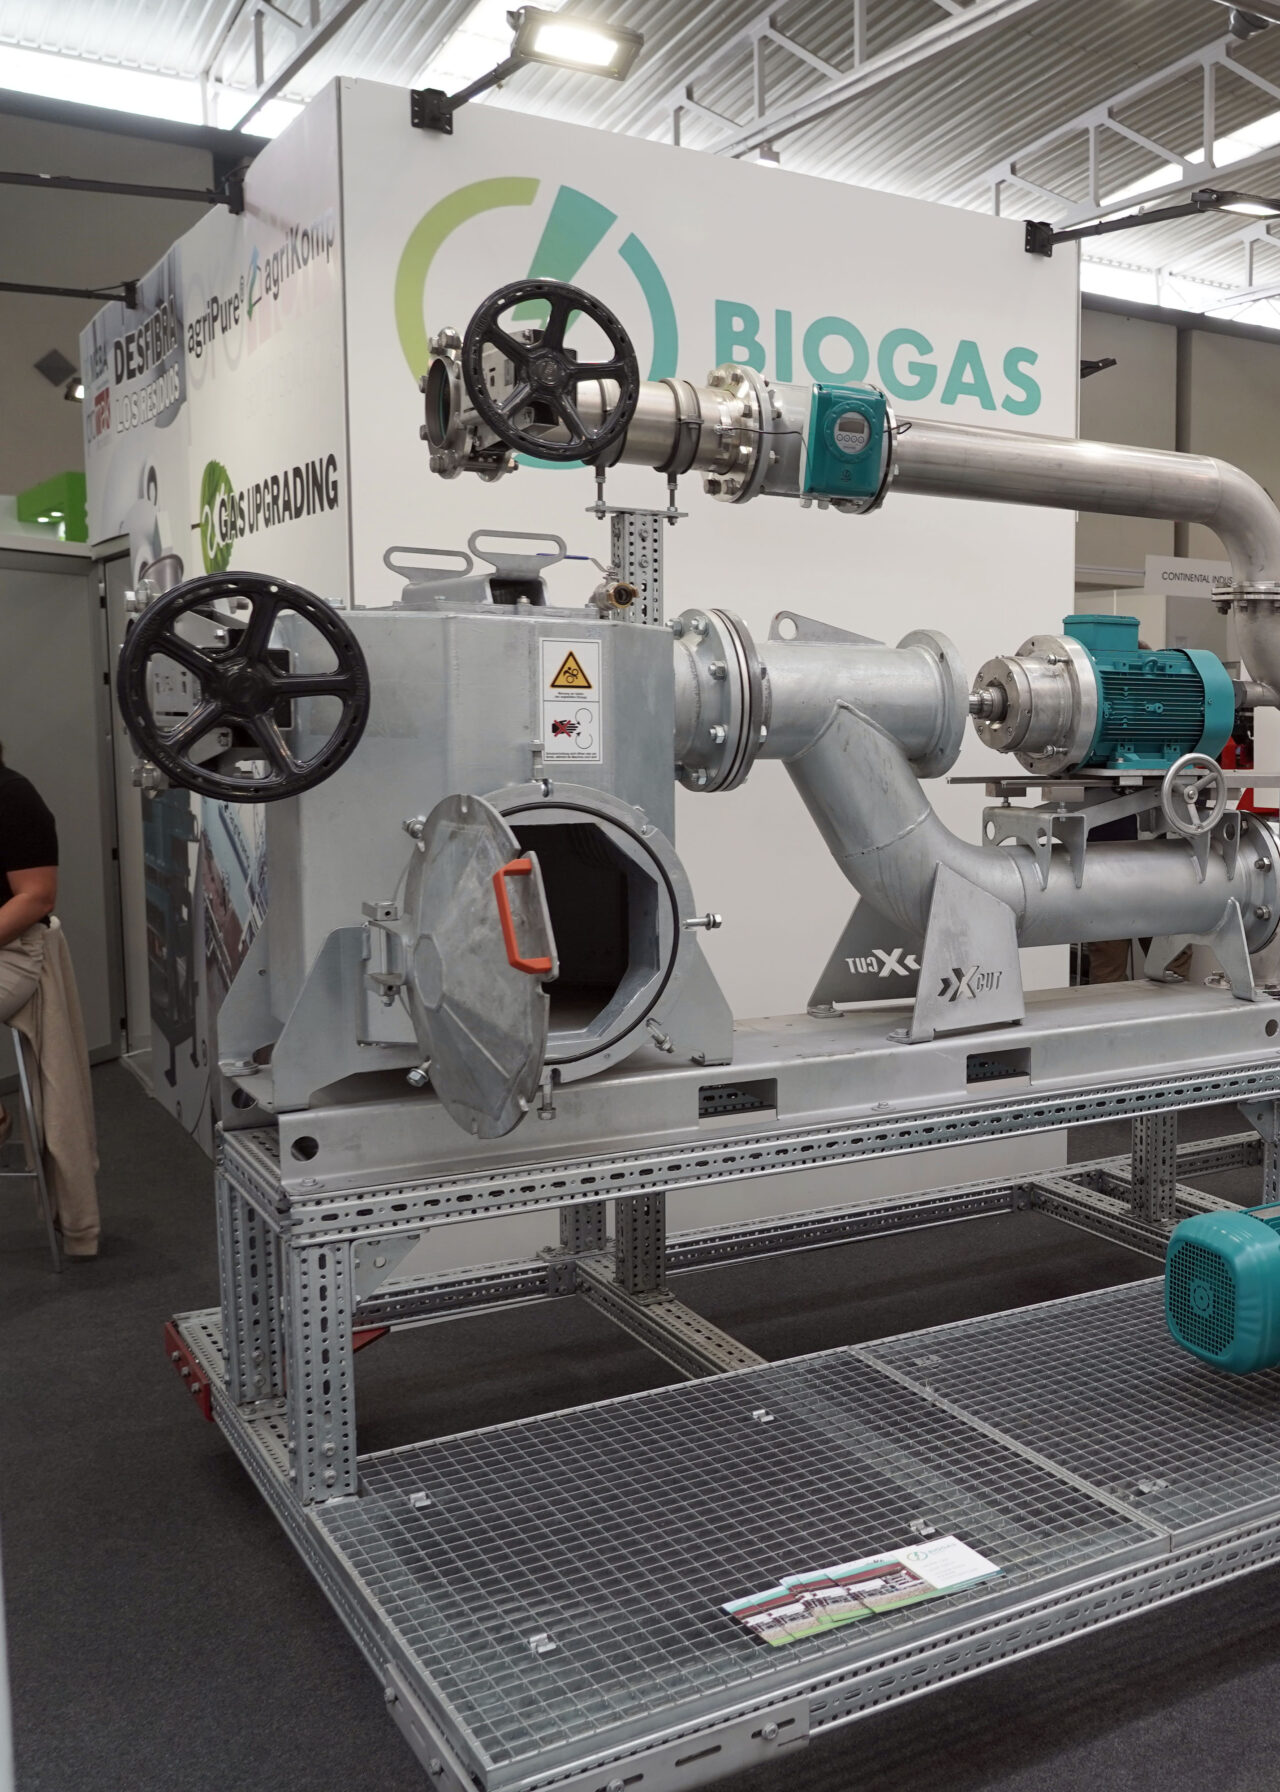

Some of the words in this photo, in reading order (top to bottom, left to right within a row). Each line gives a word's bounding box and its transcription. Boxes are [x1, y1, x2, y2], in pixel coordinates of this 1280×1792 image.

[265, 214, 335, 300] agriKomp
[114, 294, 178, 386] DESFIBRA
[715, 299, 1042, 436] BIOGAS
[116, 393, 140, 434] LOS
[140, 362, 180, 425] RESIDUOS
[219, 490, 246, 542] GAS
[247, 453, 339, 535] UPGRADING
[1162, 571, 1210, 583] CONTINENTAL
